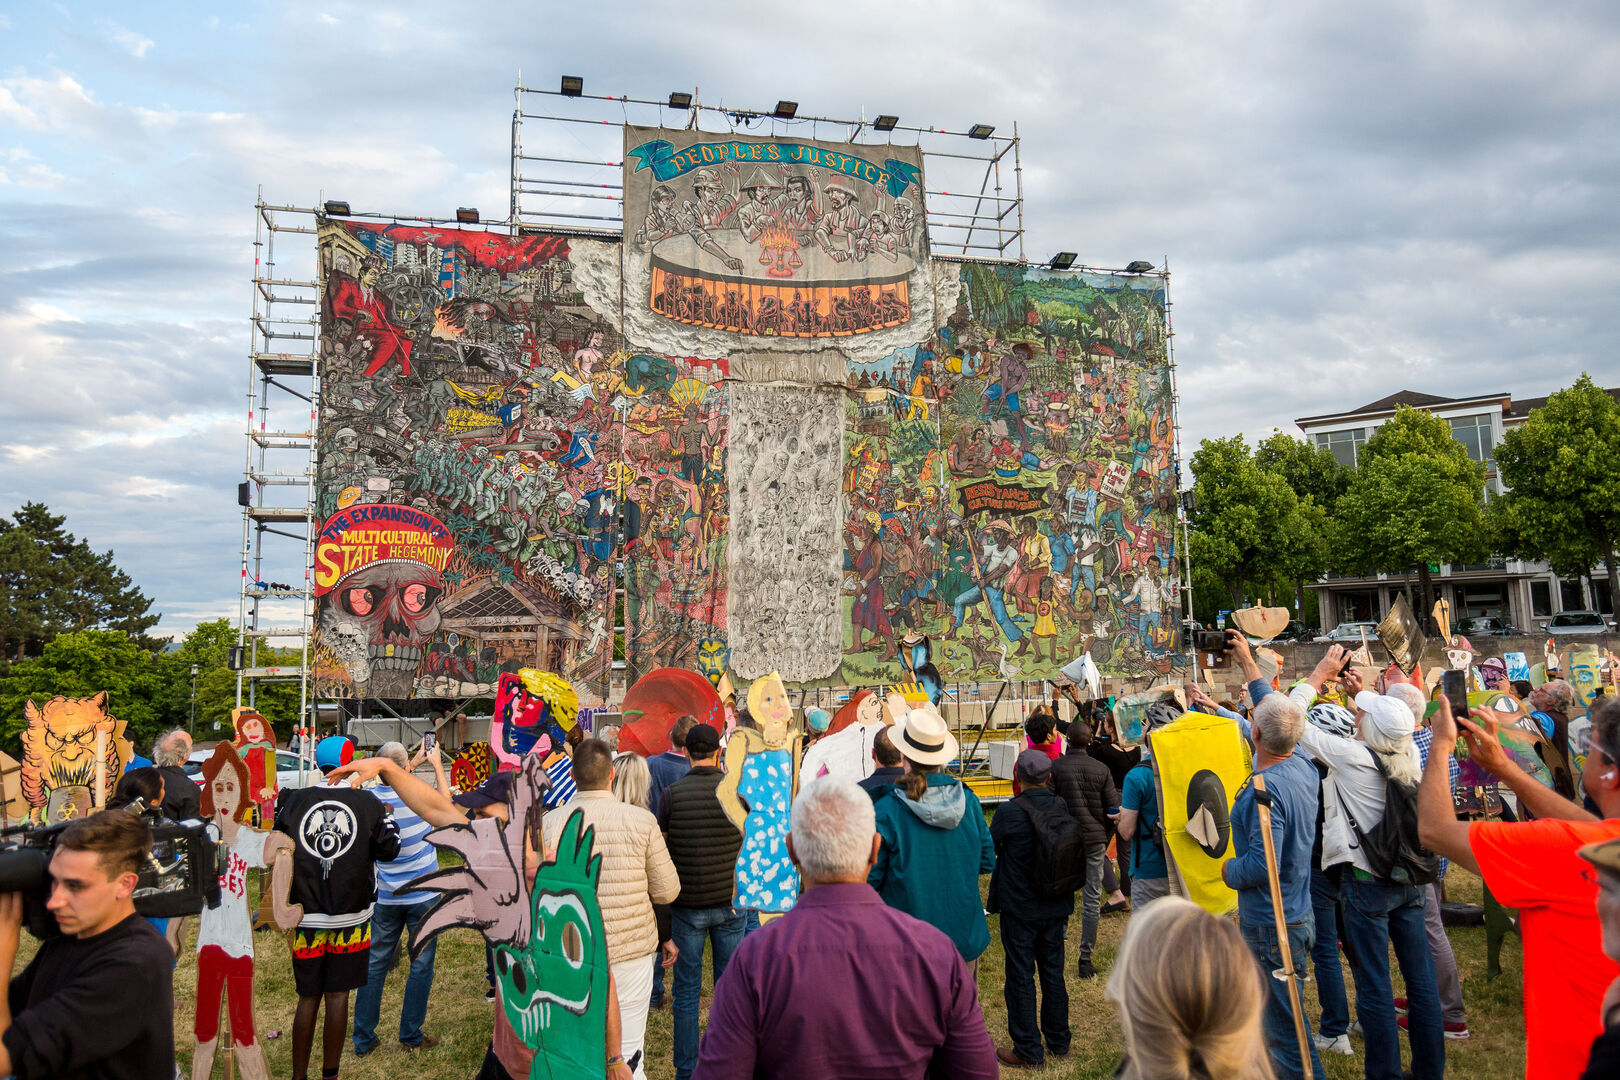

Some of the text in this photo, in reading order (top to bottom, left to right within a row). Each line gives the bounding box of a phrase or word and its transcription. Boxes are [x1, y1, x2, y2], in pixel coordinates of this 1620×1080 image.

[670, 143, 891, 188] PEOPLE'S JUSTICE
[1113, 464, 1127, 477] NO
[964, 483, 1031, 502] RESISTANCE
[967, 497, 1042, 511] CULTURE MOVEMENT
[322, 506, 450, 541] THE EXPANSION OF
[315, 543, 454, 588] STATE HEGEMONY
